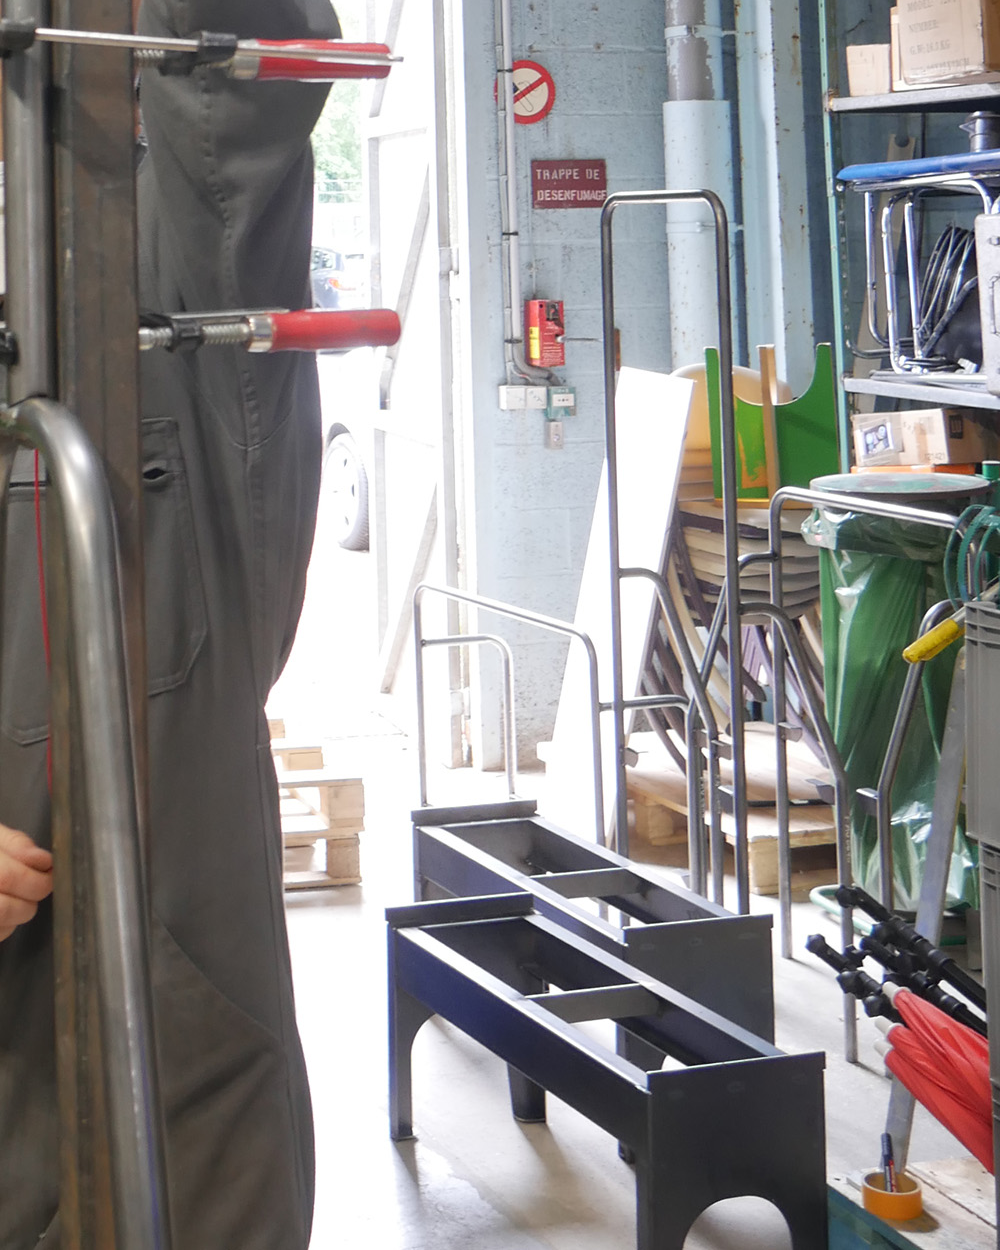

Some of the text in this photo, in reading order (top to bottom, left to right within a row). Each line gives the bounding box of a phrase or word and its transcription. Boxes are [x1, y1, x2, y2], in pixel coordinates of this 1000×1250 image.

[536, 168, 600, 180] TRAPPE DE
[536, 189, 607, 201] DESENFUMAGE
